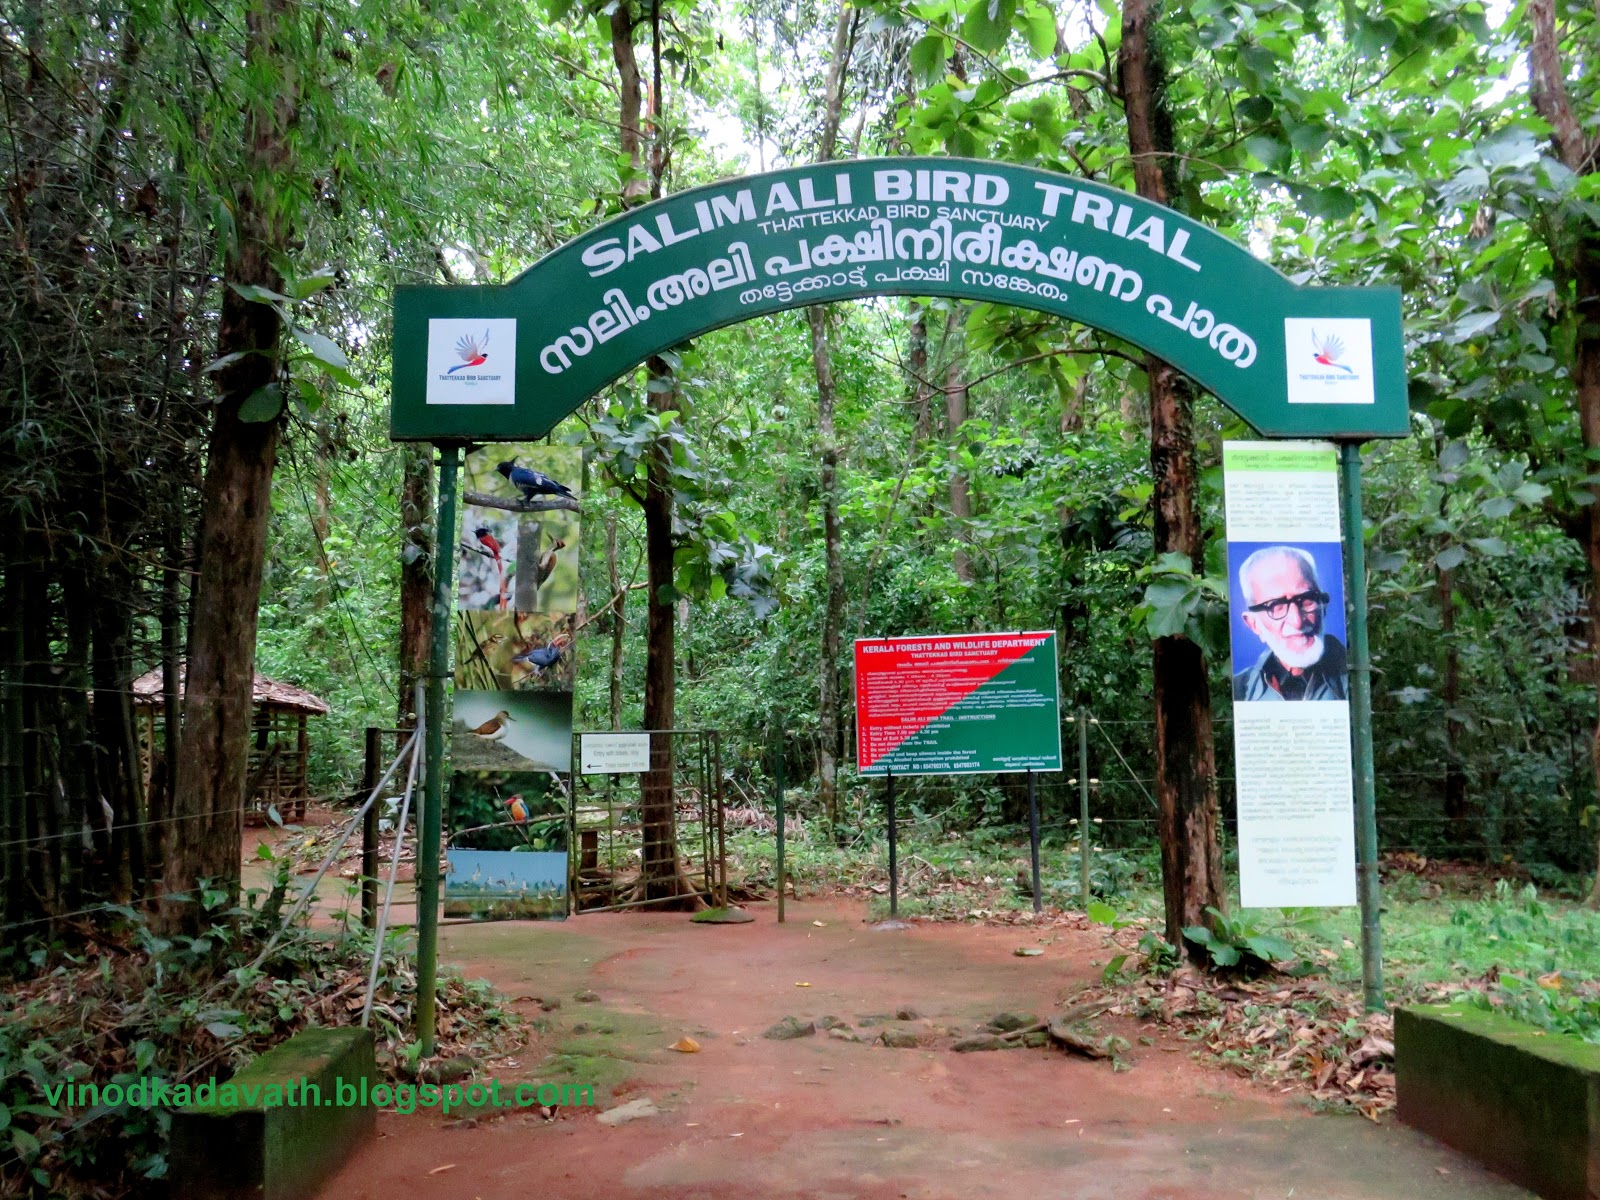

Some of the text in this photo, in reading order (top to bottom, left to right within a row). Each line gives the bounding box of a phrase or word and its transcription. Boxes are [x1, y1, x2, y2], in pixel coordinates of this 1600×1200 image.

[581, 169, 1202, 278] SALIM ALI BIRD TRIAL
[757, 205, 1050, 235] THATTEKKAD BIRD SANCTUARY
[874, 260, 950, 282] പക്ഷി
[1145, 294, 1257, 369] പാത
[863, 638, 1047, 654] KERALA FORESTS AND WILDLIFE DEPARTMENT
